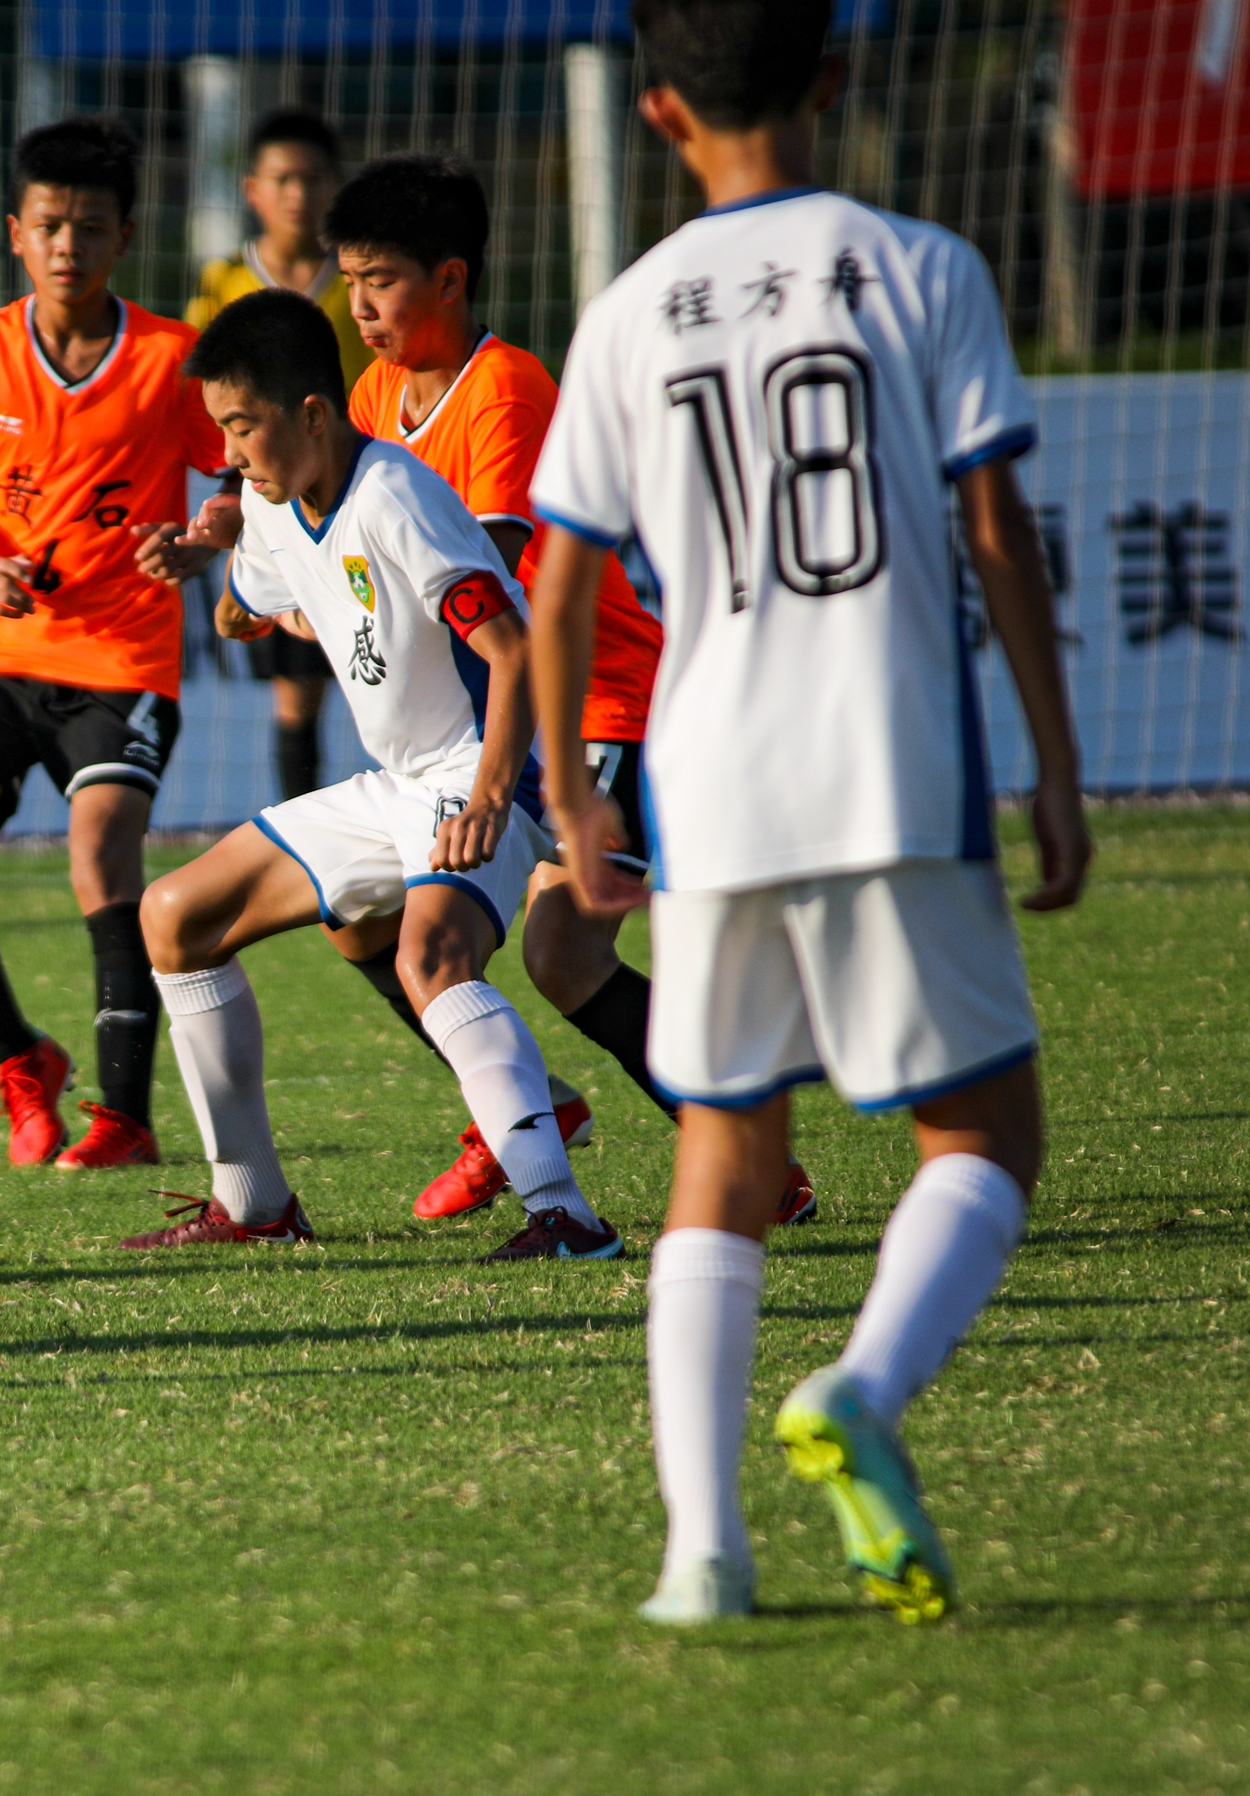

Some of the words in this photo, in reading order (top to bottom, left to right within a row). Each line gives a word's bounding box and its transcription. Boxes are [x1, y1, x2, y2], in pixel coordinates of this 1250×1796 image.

[658, 247, 881, 333] 程方舟
[665, 342, 884, 614] 18
[449, 587, 485, 623] C
[348, 615, 387, 685] 感
